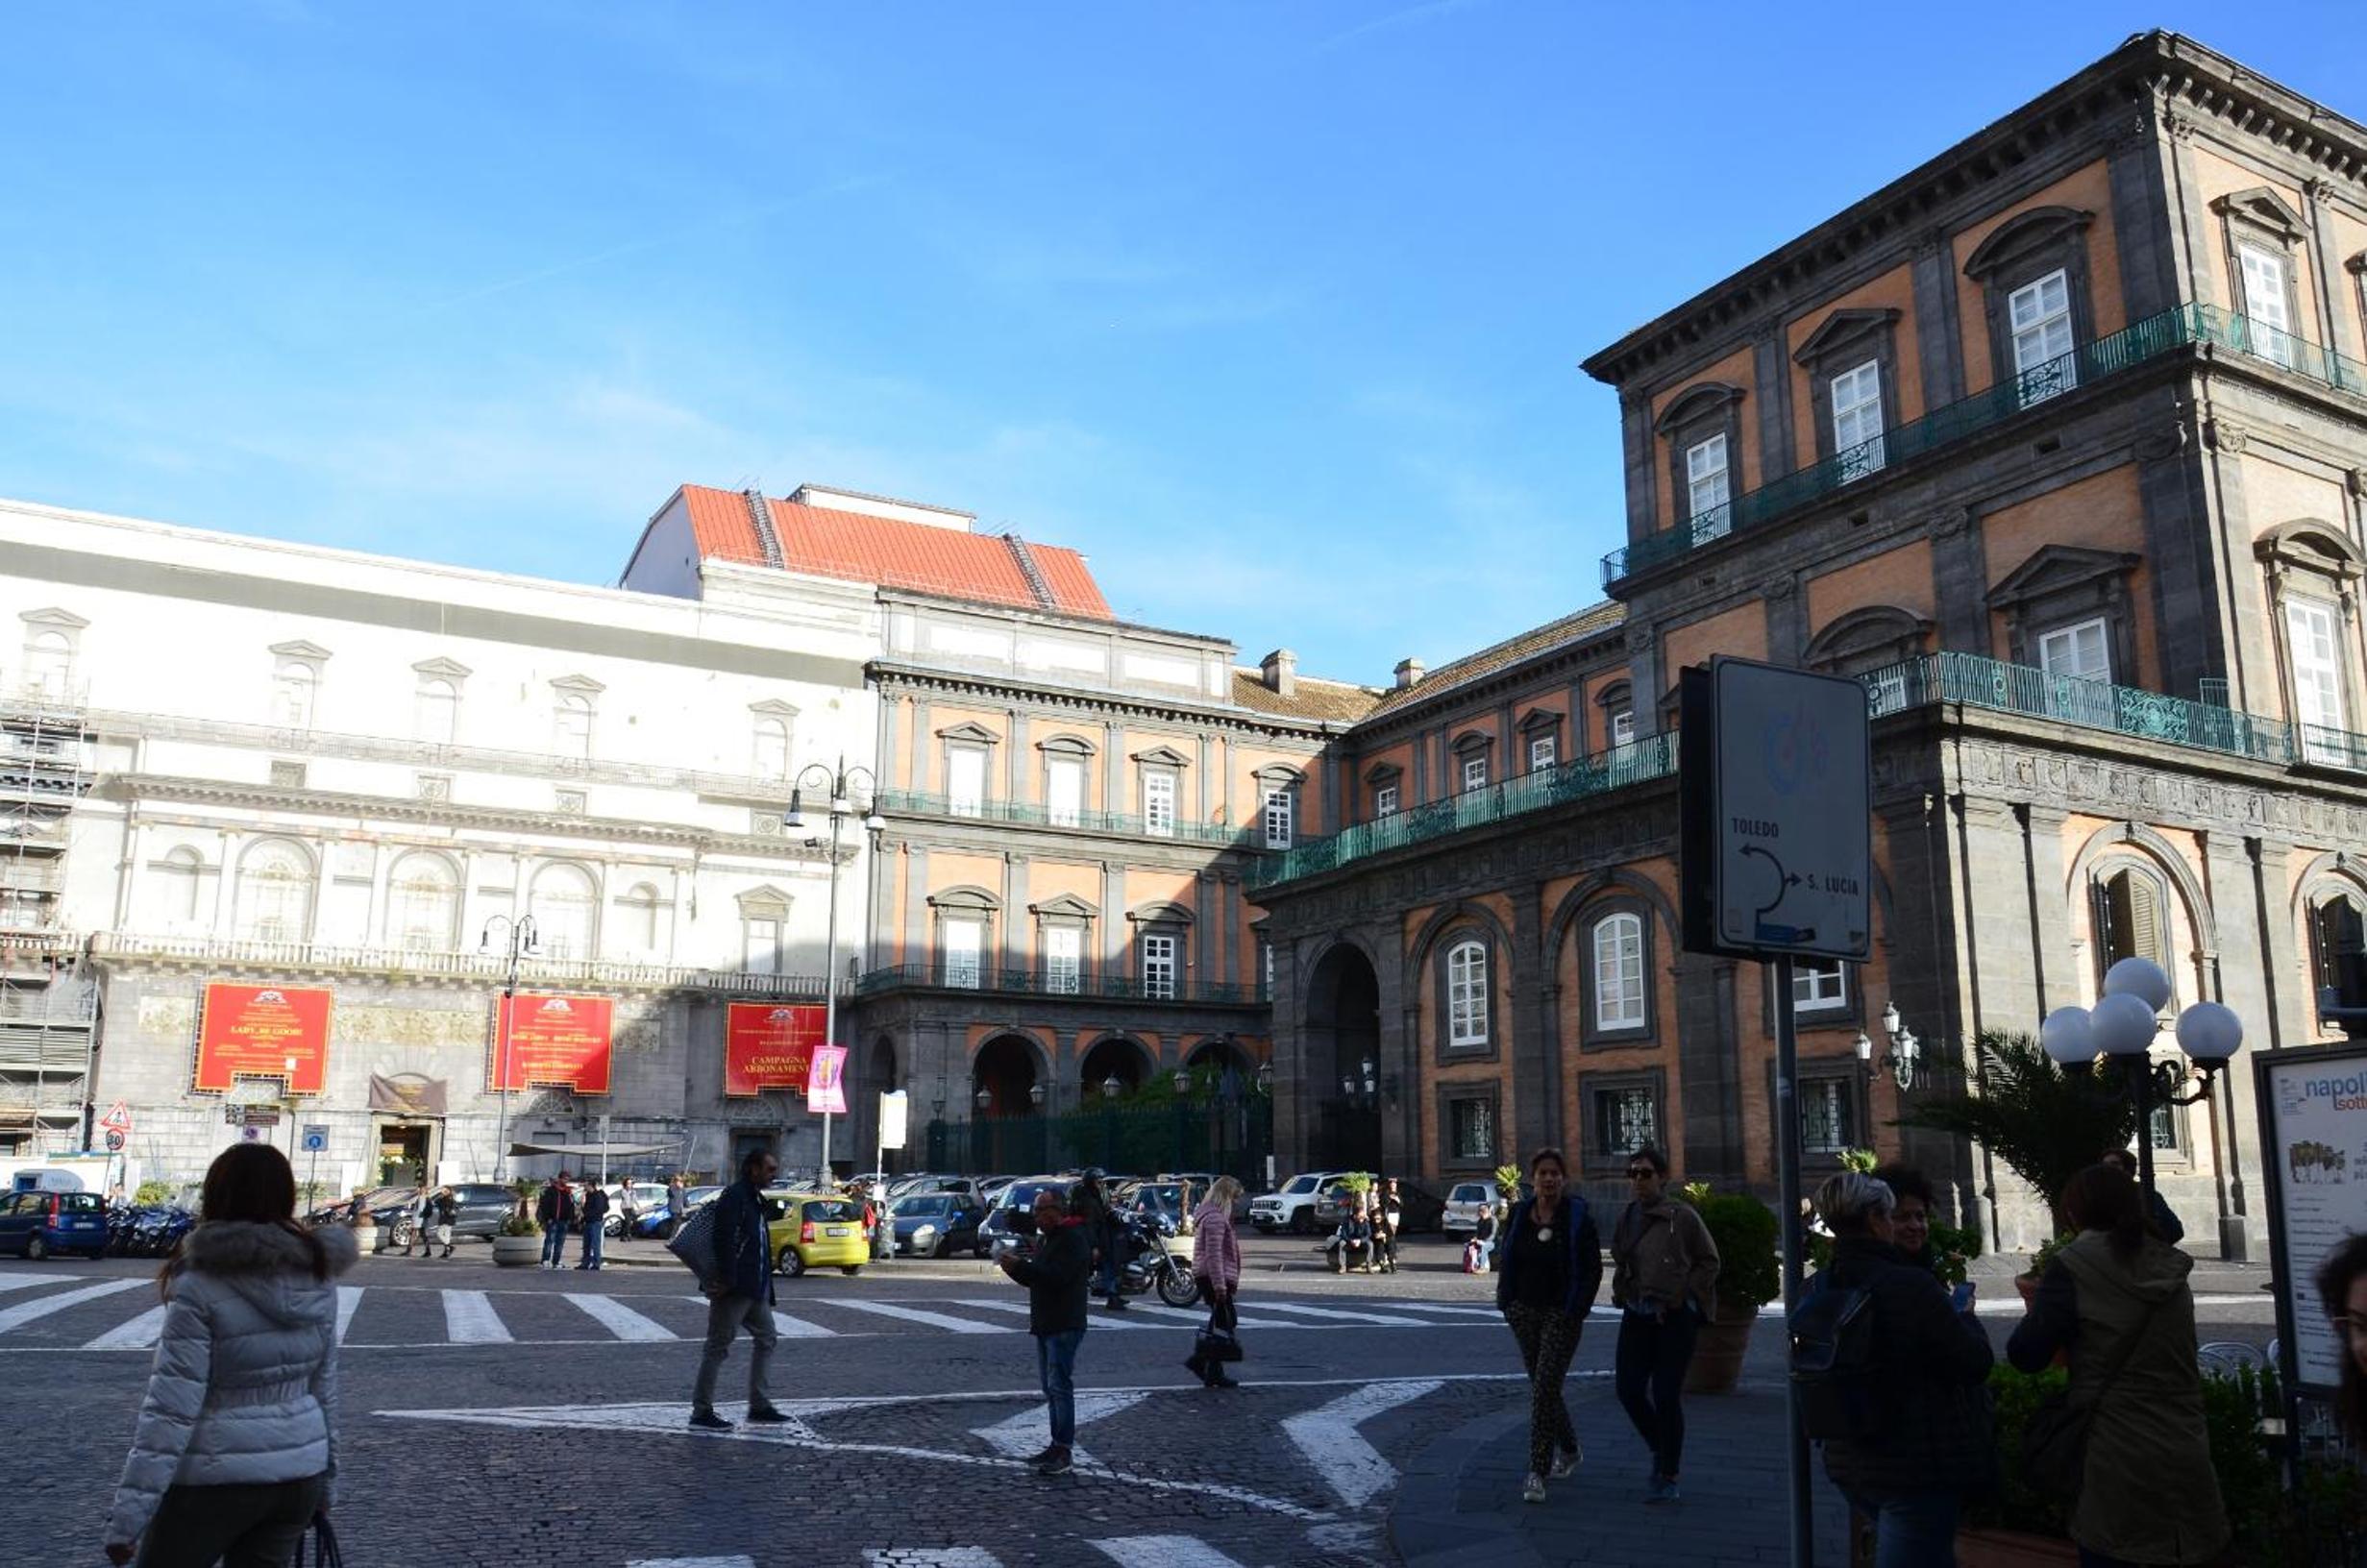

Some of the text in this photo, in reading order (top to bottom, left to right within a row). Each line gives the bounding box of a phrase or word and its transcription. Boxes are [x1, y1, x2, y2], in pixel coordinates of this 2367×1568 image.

[1732, 818, 1779, 838] TOLEDO
[1807, 873, 1860, 895] S. LUCIA
[752, 1056, 806, 1065] CAMPAGNA
[742, 1065, 809, 1074] ABBONAMENT
[108, 1134, 120, 1145] 30
